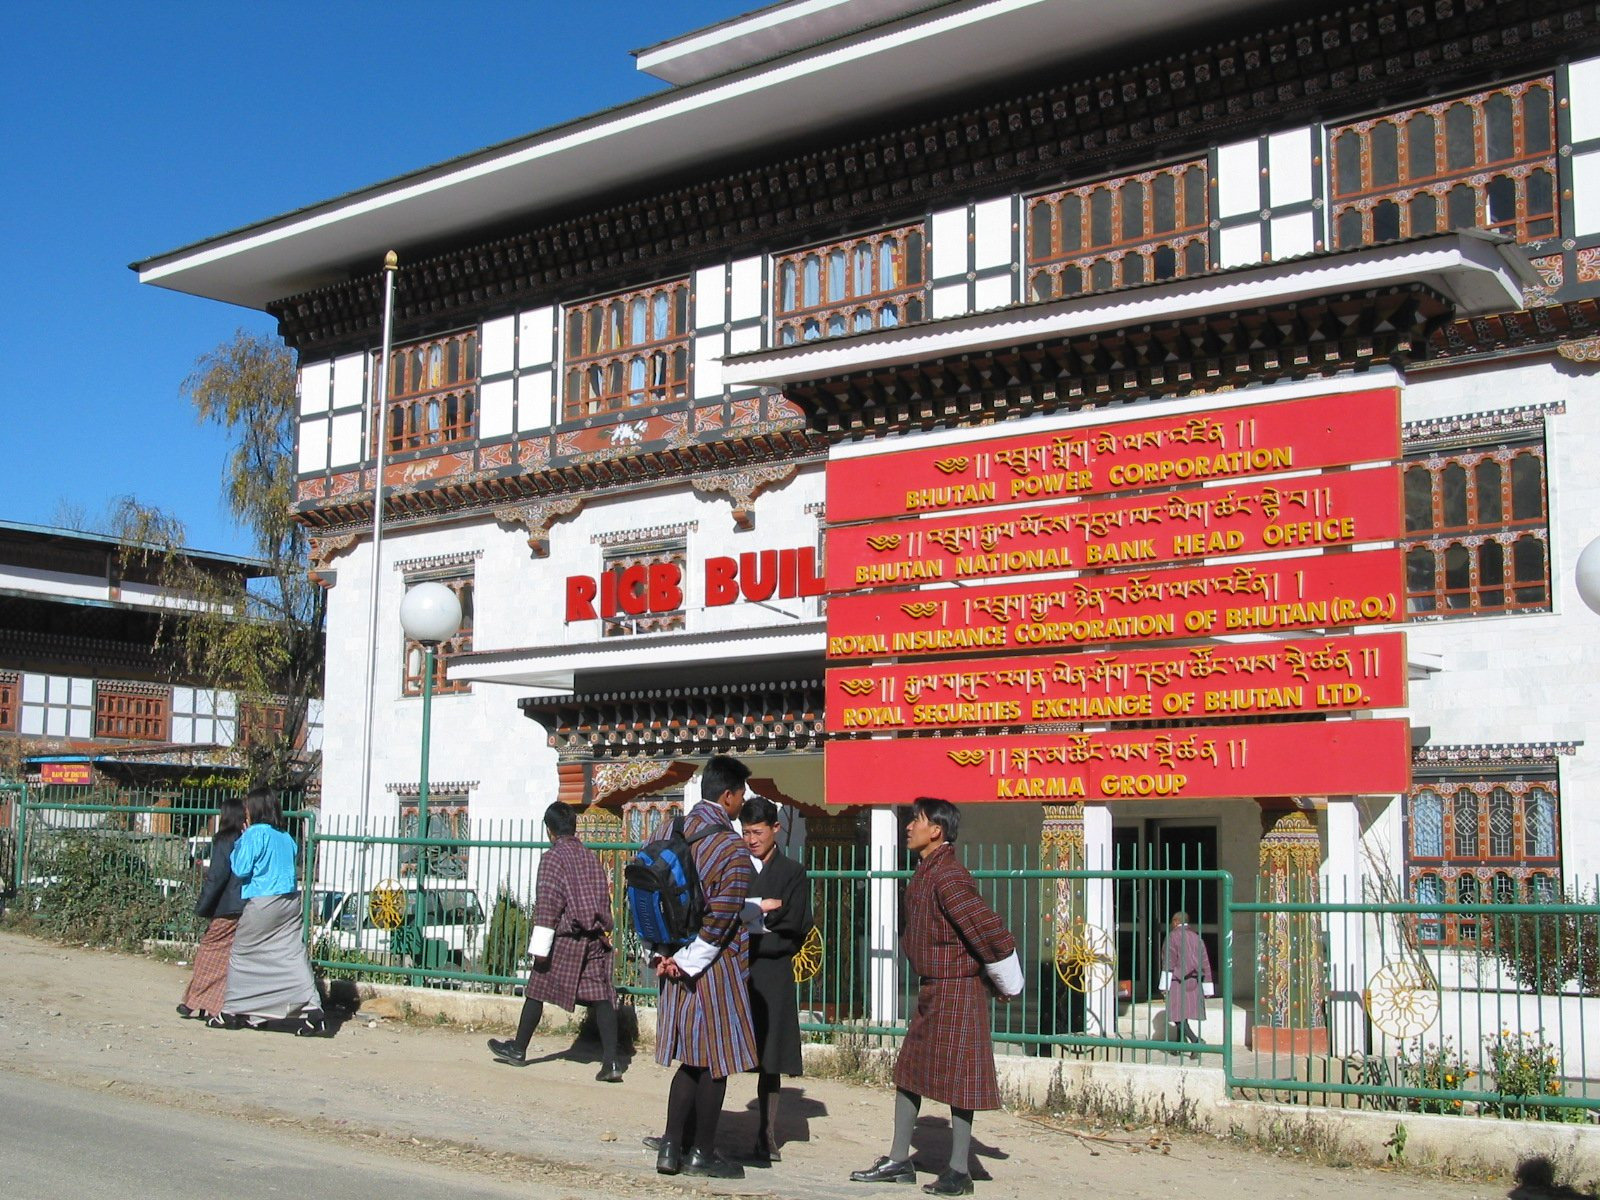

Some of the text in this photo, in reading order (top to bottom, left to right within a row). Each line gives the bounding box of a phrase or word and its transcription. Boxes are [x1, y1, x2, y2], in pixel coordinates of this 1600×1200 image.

[905, 447, 1293, 509] BHUTAN POWER CORPORATION
[856, 517, 1355, 583] BHUTAN NATIONAL BANK HEAD OFFICE
[565, 563, 684, 622] RICB
[829, 593, 1396, 655] ROYAL INSURANCE CORPORATION OF BHUTAN (R.O.)
[843, 683, 1371, 726] ROYAL SECURITIES EXCHANGE OF BHUTAN LTD.
[997, 774, 1187, 798] KARMA GROUP
